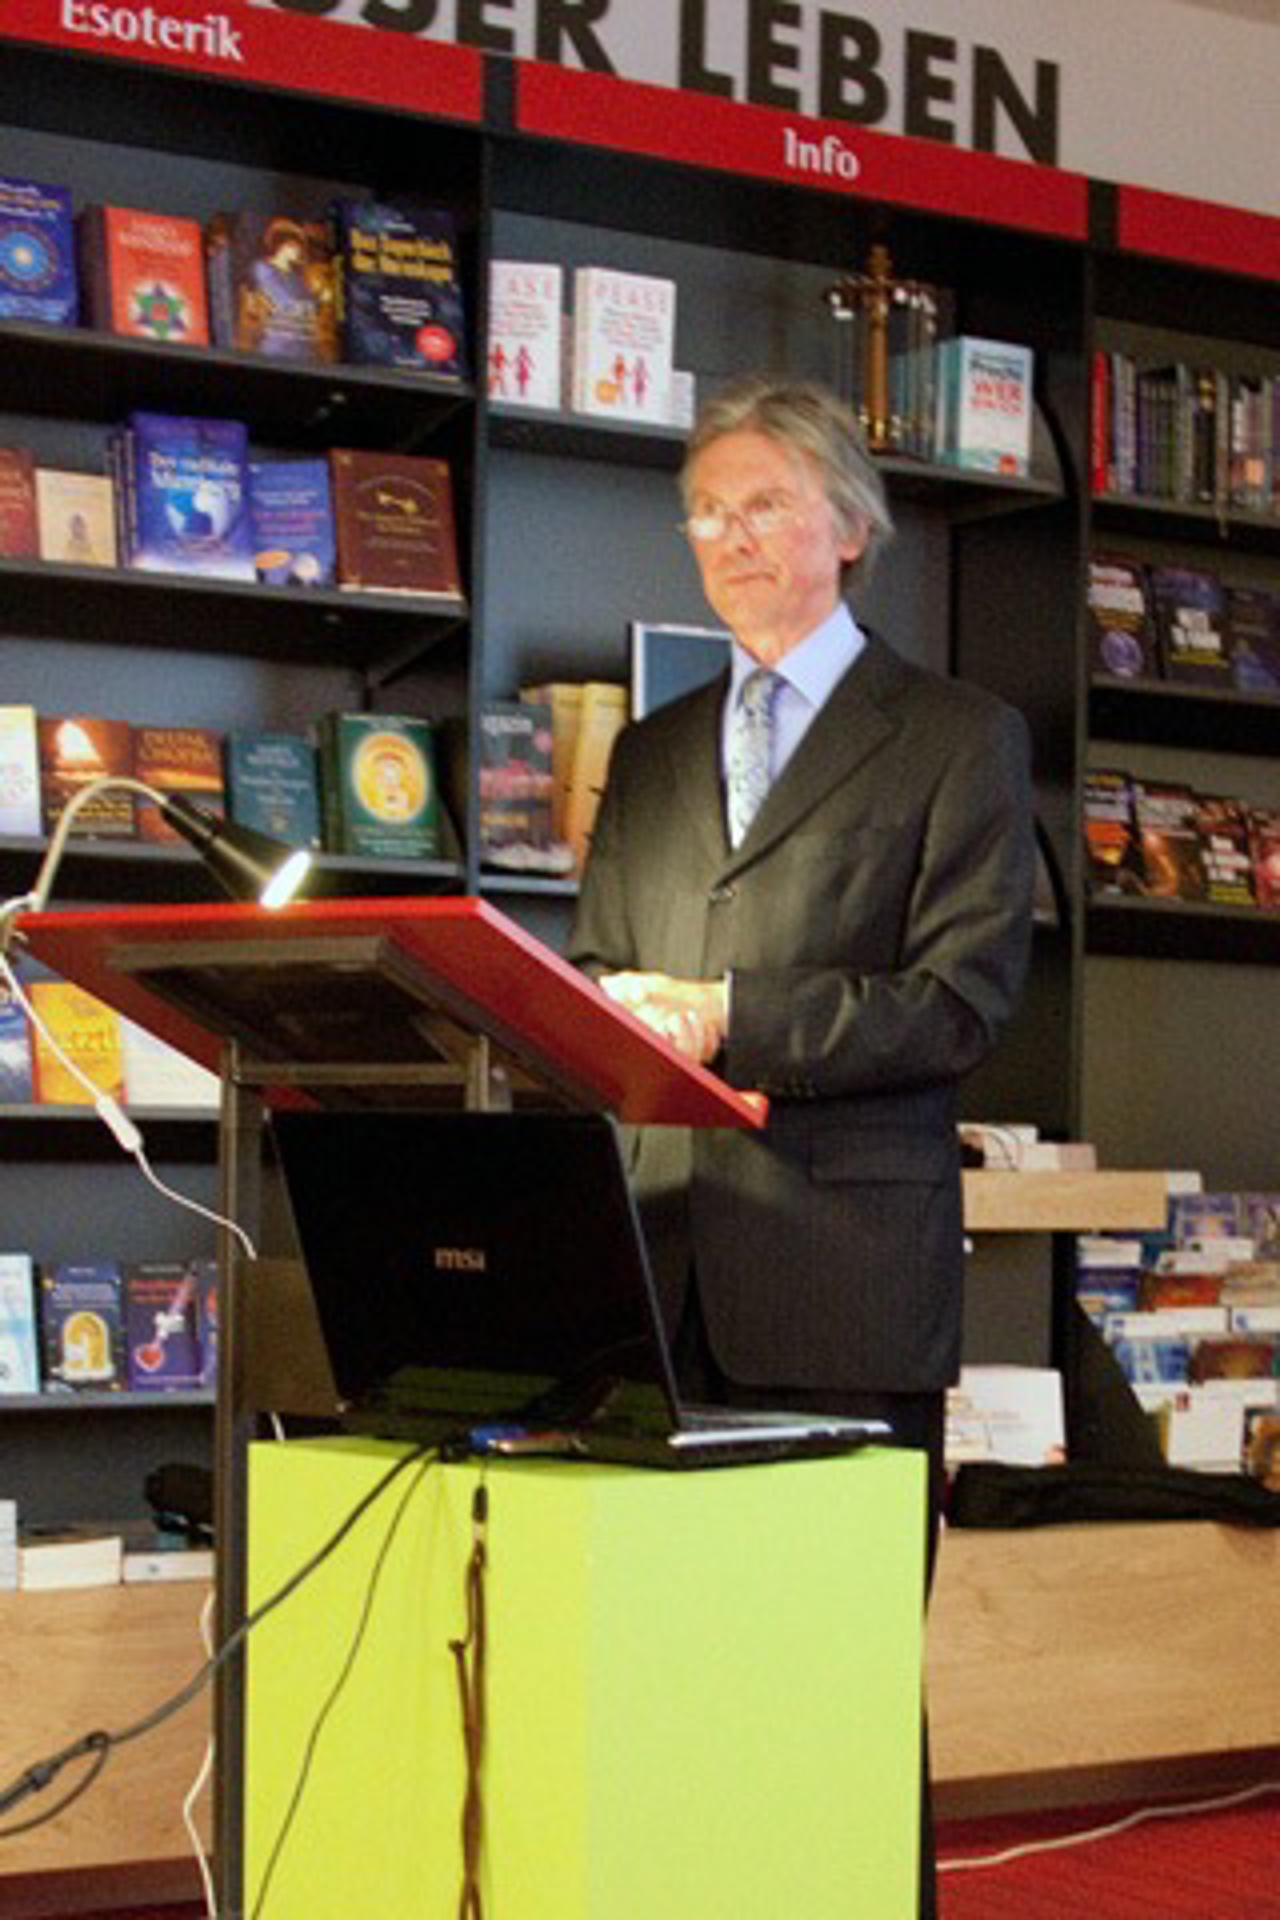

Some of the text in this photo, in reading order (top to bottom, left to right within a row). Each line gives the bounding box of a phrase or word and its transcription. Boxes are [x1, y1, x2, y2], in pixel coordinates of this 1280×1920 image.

[61, 0, 244, 62] Esoterik
[679, 0, 1059, 167] LEBEN
[783, 127, 860, 180] Info
[434, 1246, 486, 1272] msi
